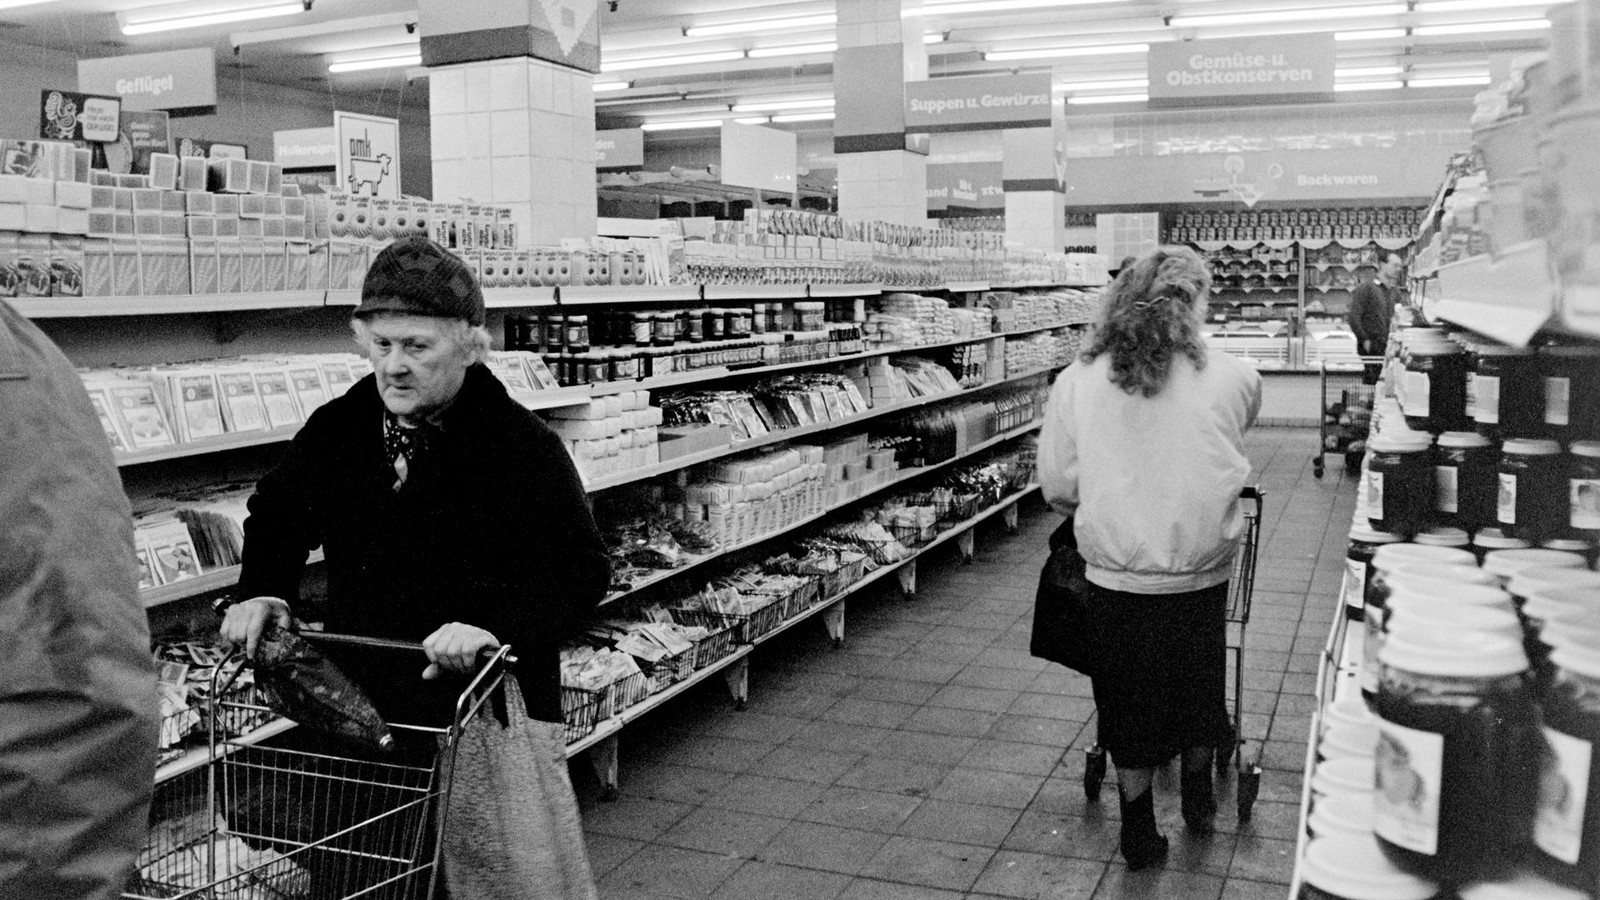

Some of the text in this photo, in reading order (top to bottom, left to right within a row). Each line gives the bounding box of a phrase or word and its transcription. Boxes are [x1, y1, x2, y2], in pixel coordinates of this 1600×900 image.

[116, 74, 173, 96] Geflügel
[1166, 69, 1313, 87] Obstkonserven
[910, 92, 1049, 114] Suppen u. Gewürze
[1297, 173, 1379, 187] Backwaren
